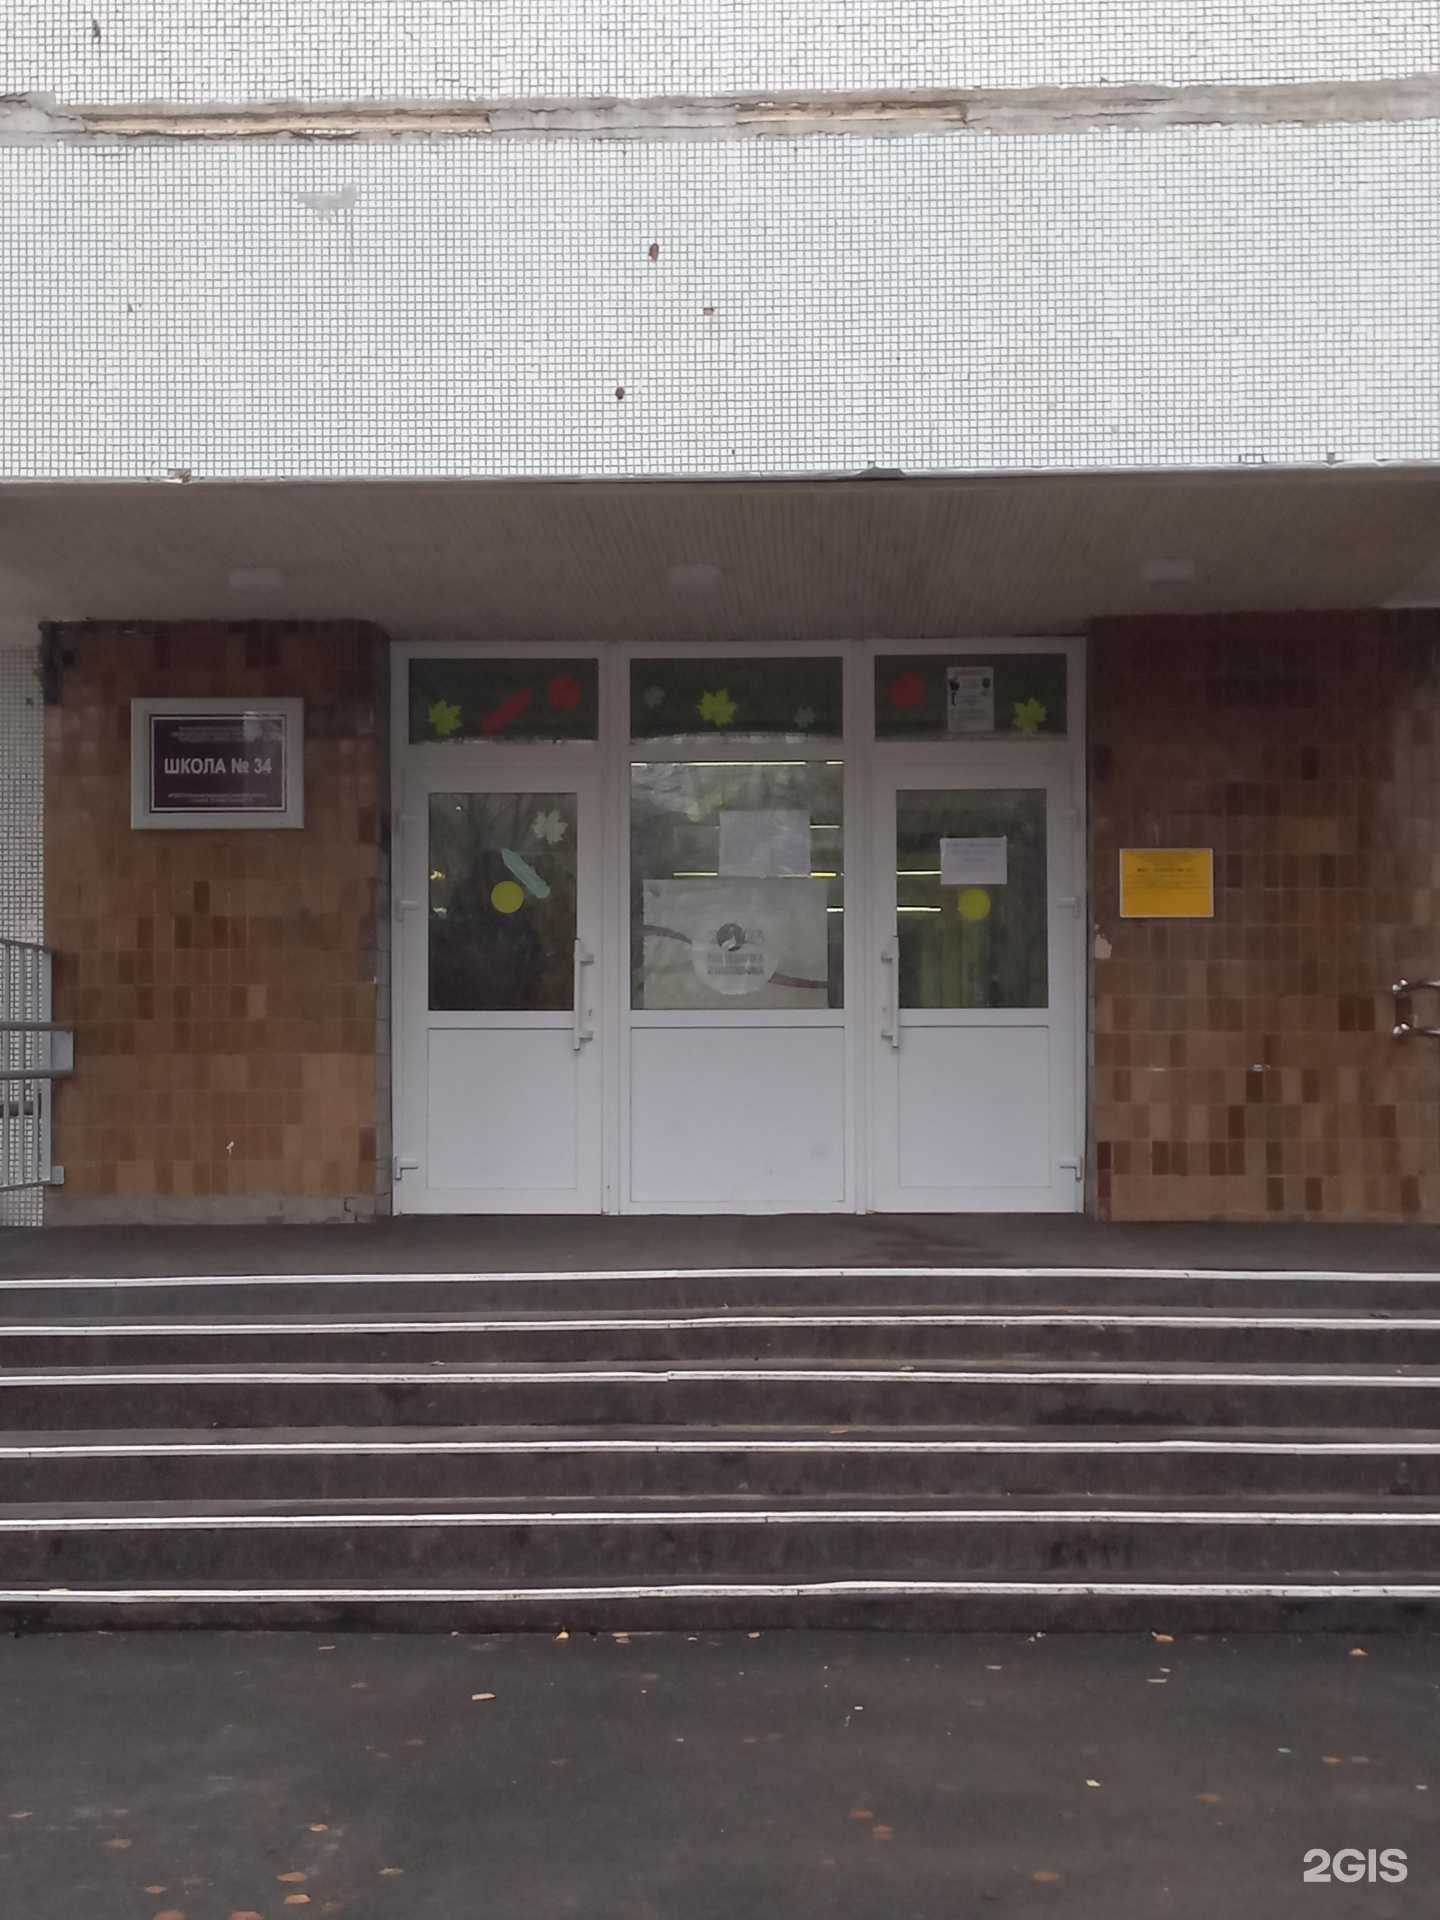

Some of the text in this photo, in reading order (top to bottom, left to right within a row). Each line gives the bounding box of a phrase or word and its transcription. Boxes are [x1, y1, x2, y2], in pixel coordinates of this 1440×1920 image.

[164, 758, 273, 774] ШКОЛА № 34
